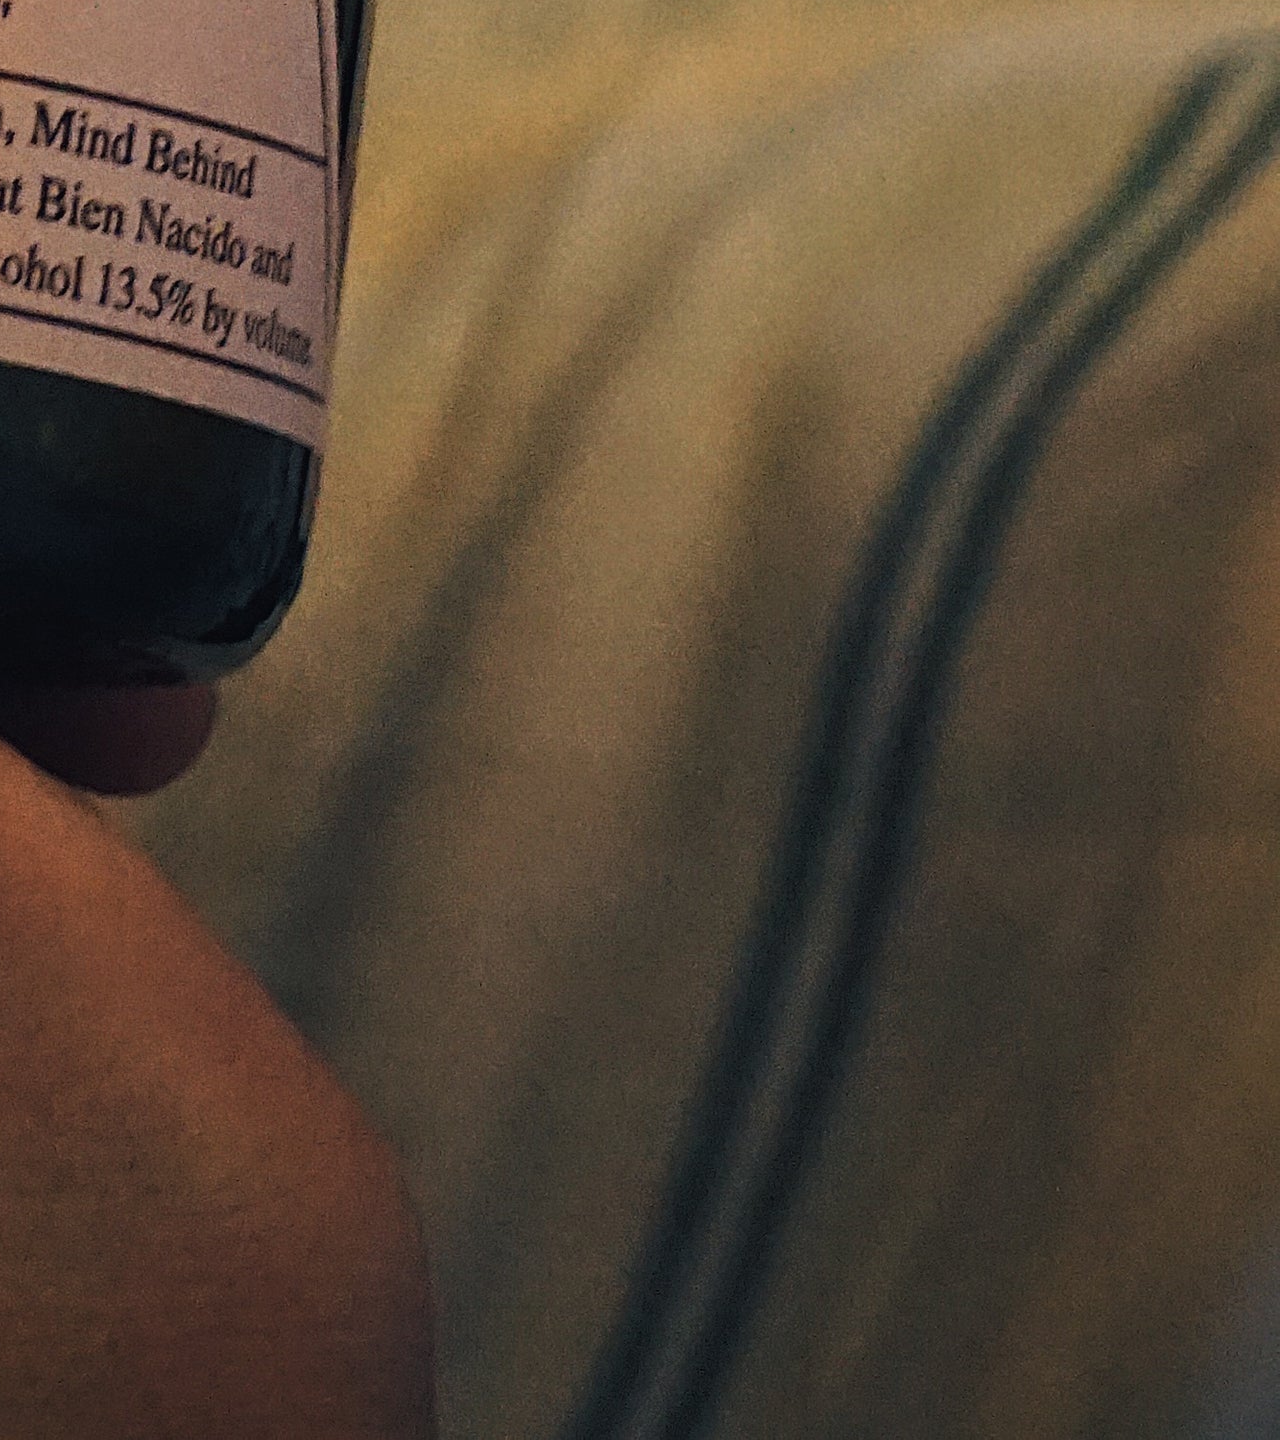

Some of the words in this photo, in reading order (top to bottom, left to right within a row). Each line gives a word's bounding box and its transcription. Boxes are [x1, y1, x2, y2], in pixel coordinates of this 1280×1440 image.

[30, 101, 137, 168] Mind
[145, 128, 259, 200] Behind
[36, 175, 126, 238] Bien
[136, 197, 247, 269] Nacido
[249, 241, 295, 287] and
[98, 262, 196, 328] 13.5%
[202, 287, 236, 349] by
